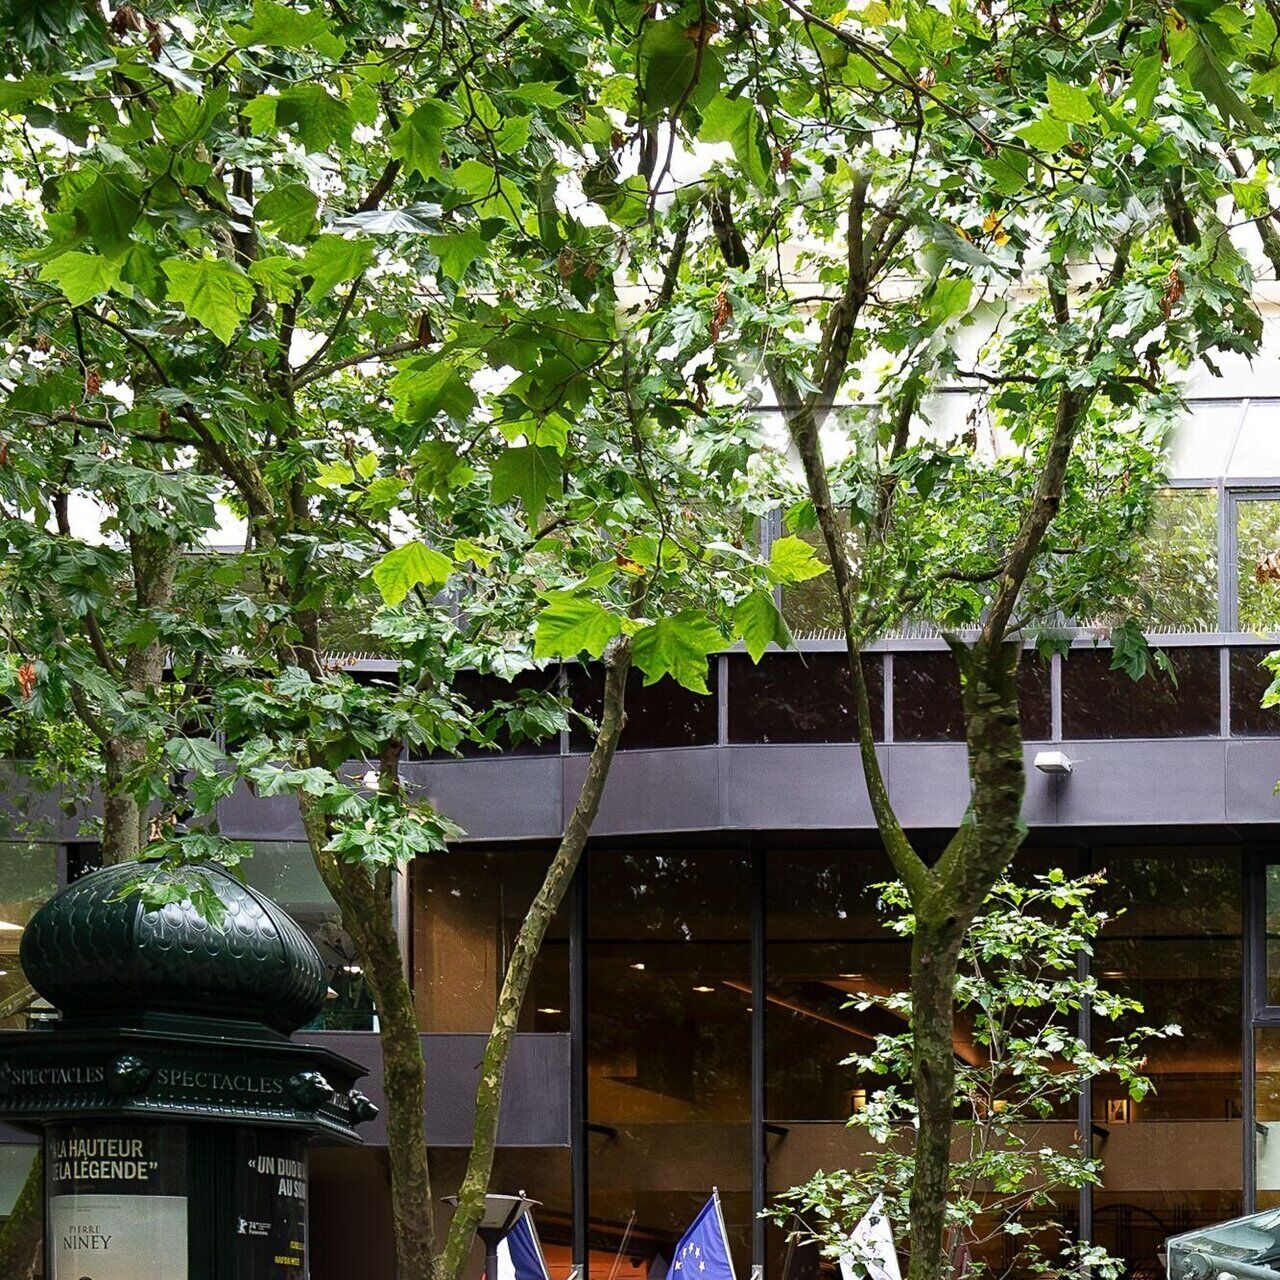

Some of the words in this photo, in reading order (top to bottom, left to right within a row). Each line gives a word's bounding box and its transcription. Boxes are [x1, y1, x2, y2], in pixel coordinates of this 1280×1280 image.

[11, 1066, 105, 1085] SPECTACLES
[157, 1068, 284, 1095] SPECTACLES
[69, 1138, 144, 1158] HAUTEUR
[62, 1235, 112, 1250] NINEY
